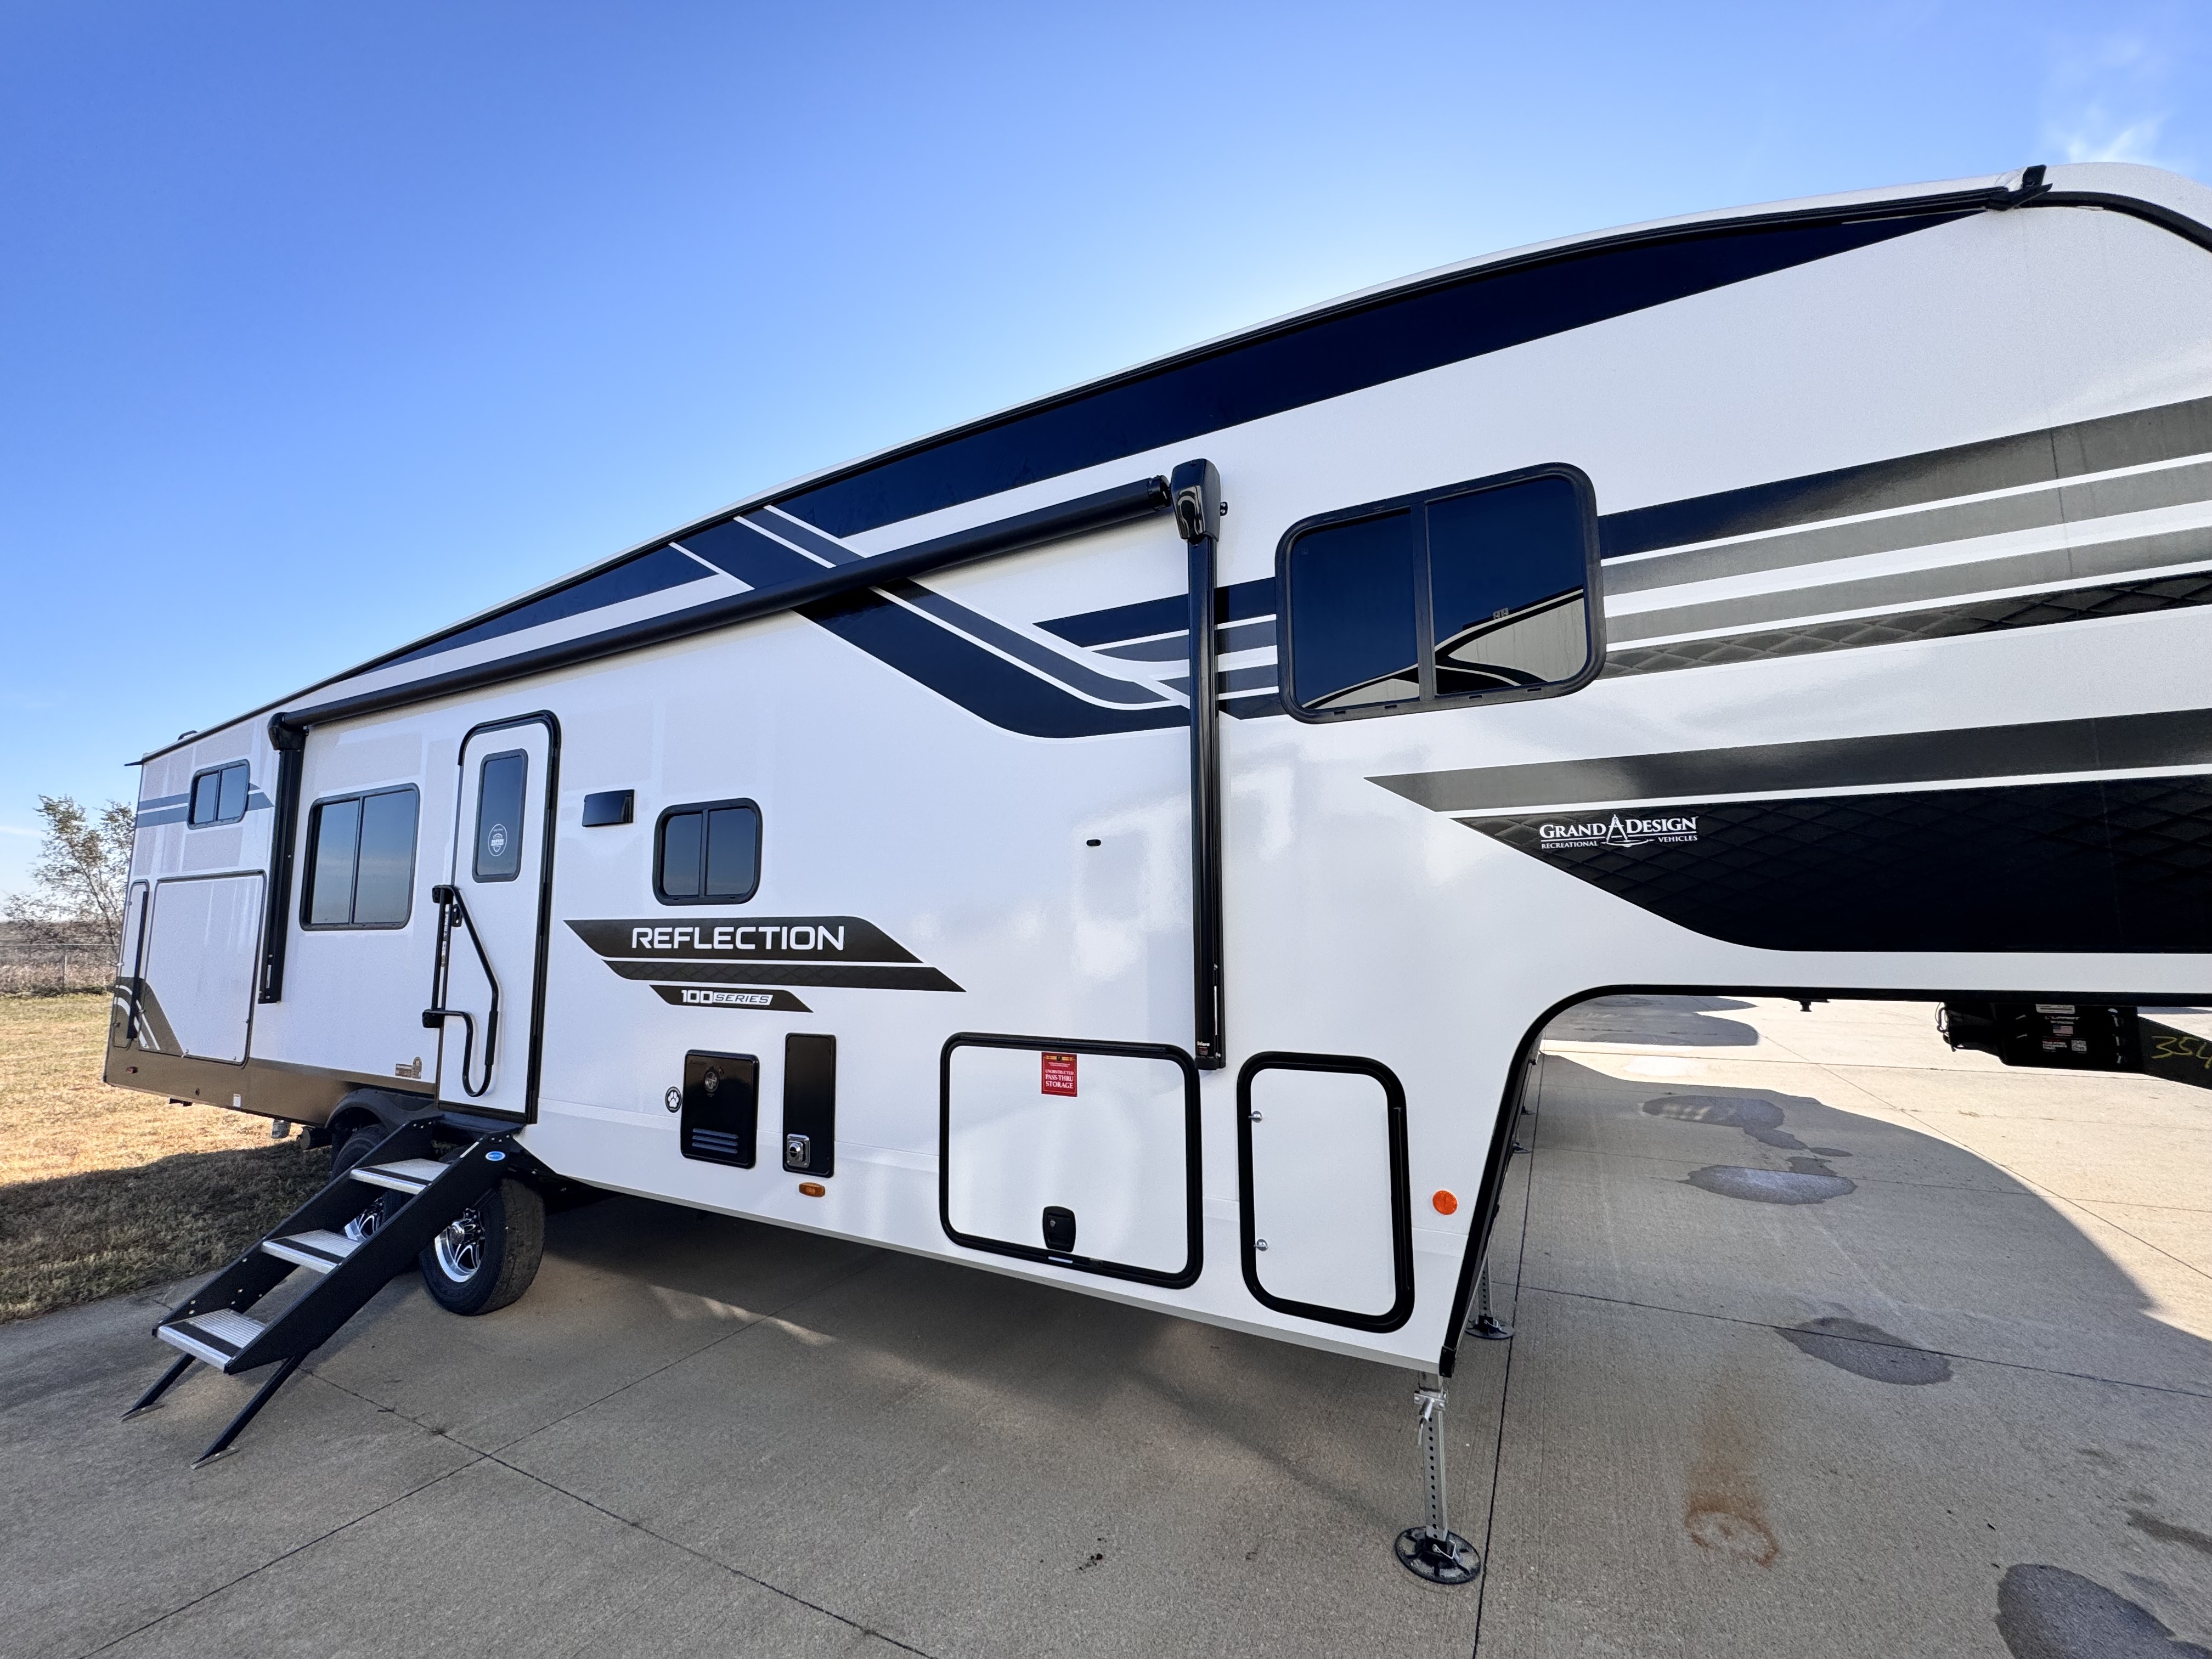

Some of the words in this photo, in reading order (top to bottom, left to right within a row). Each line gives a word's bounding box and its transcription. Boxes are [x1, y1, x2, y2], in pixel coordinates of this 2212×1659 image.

[1539, 823, 1606, 838] GRAND
[1625, 817, 1697, 833] DESIGN
[1541, 840, 1599, 849] RECREATIONAL
[631, 926, 844, 951] REFLECTION
[681, 990, 713, 1004] 100
[715, 994, 770, 1003] SERIES
[1045, 1074, 1074, 1082] PASS-THRU
[1046, 1080, 1074, 1089] STORAGE
